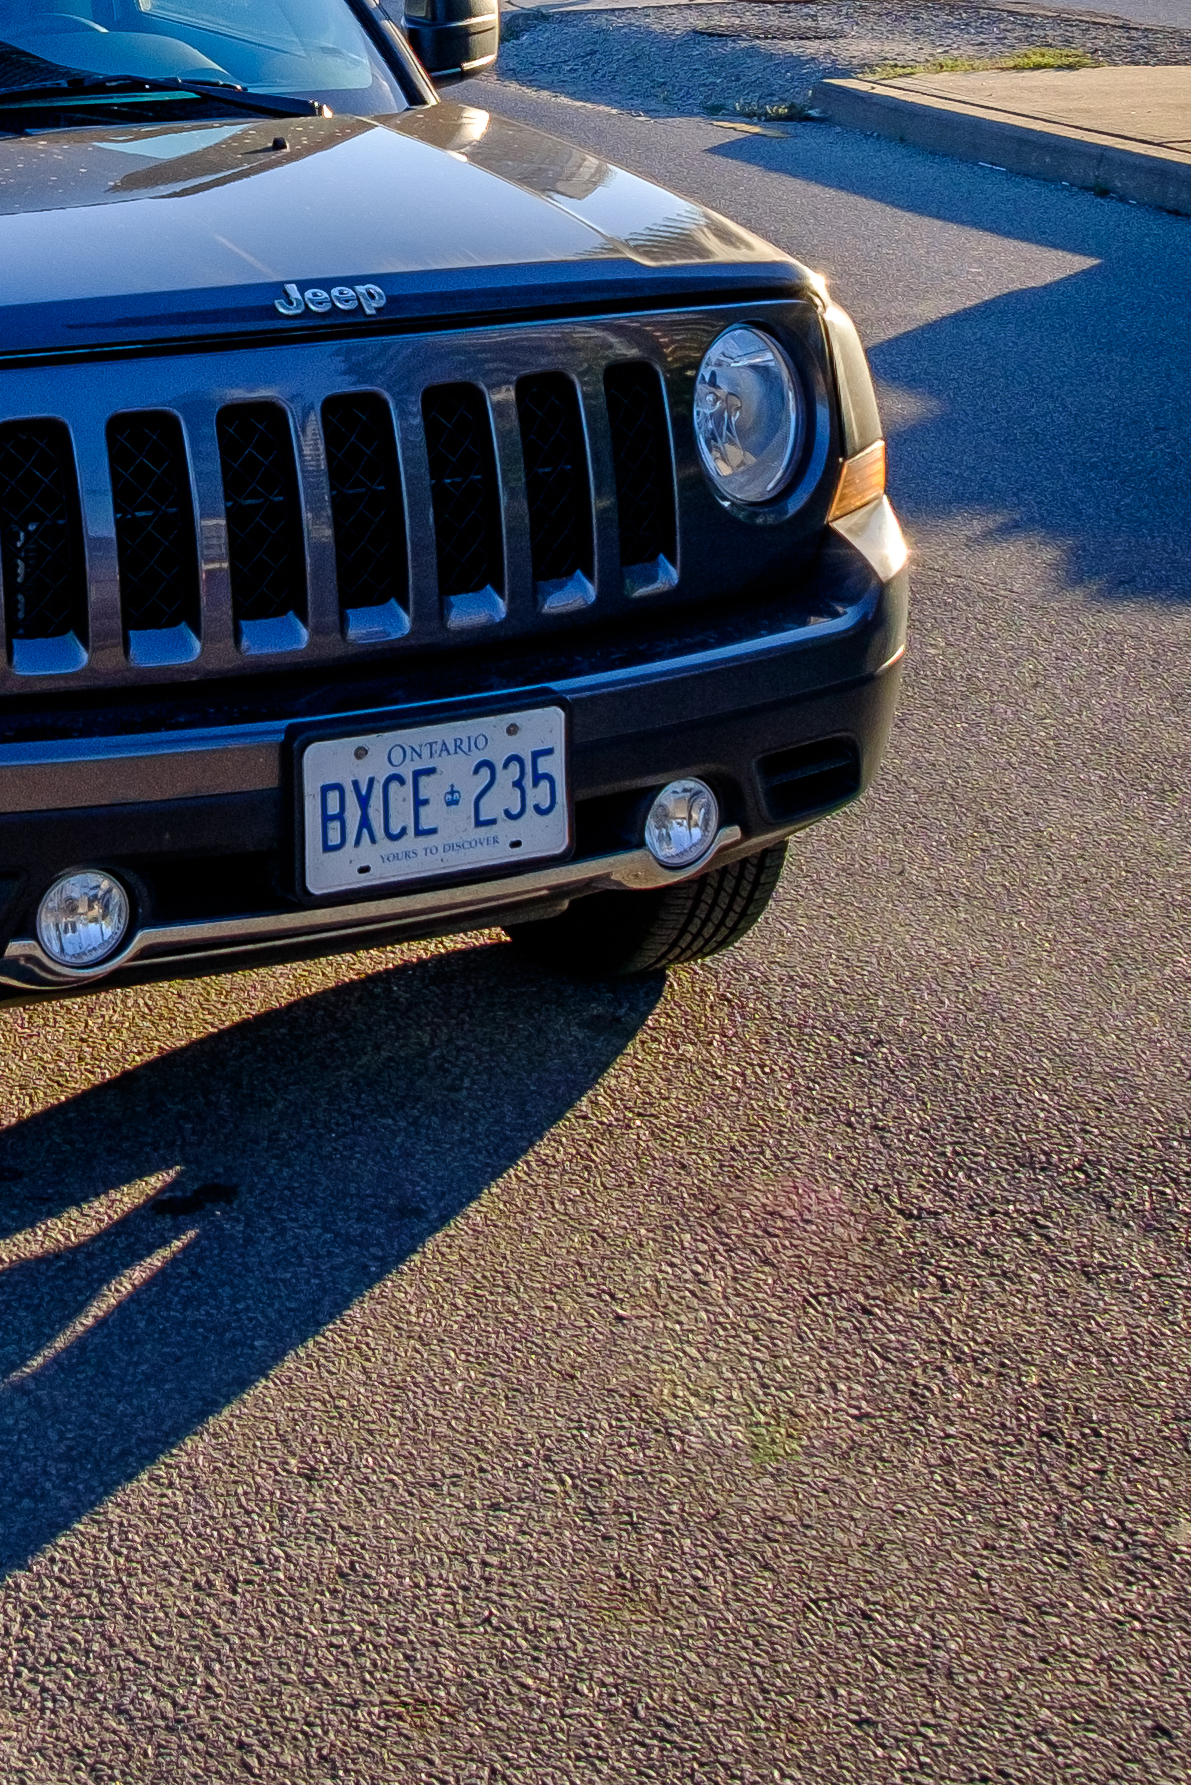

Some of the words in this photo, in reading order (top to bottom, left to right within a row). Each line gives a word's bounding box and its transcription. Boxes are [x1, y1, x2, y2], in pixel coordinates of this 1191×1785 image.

[274, 283, 387, 316] Jeep
[387, 733, 490, 767] ONTARIO
[320, 766, 438, 854] BXCE
[472, 746, 557, 829] 235
[380, 848, 418, 864] YOURS
[423, 844, 439, 857] TO
[442, 834, 500, 854] DISCOVER
